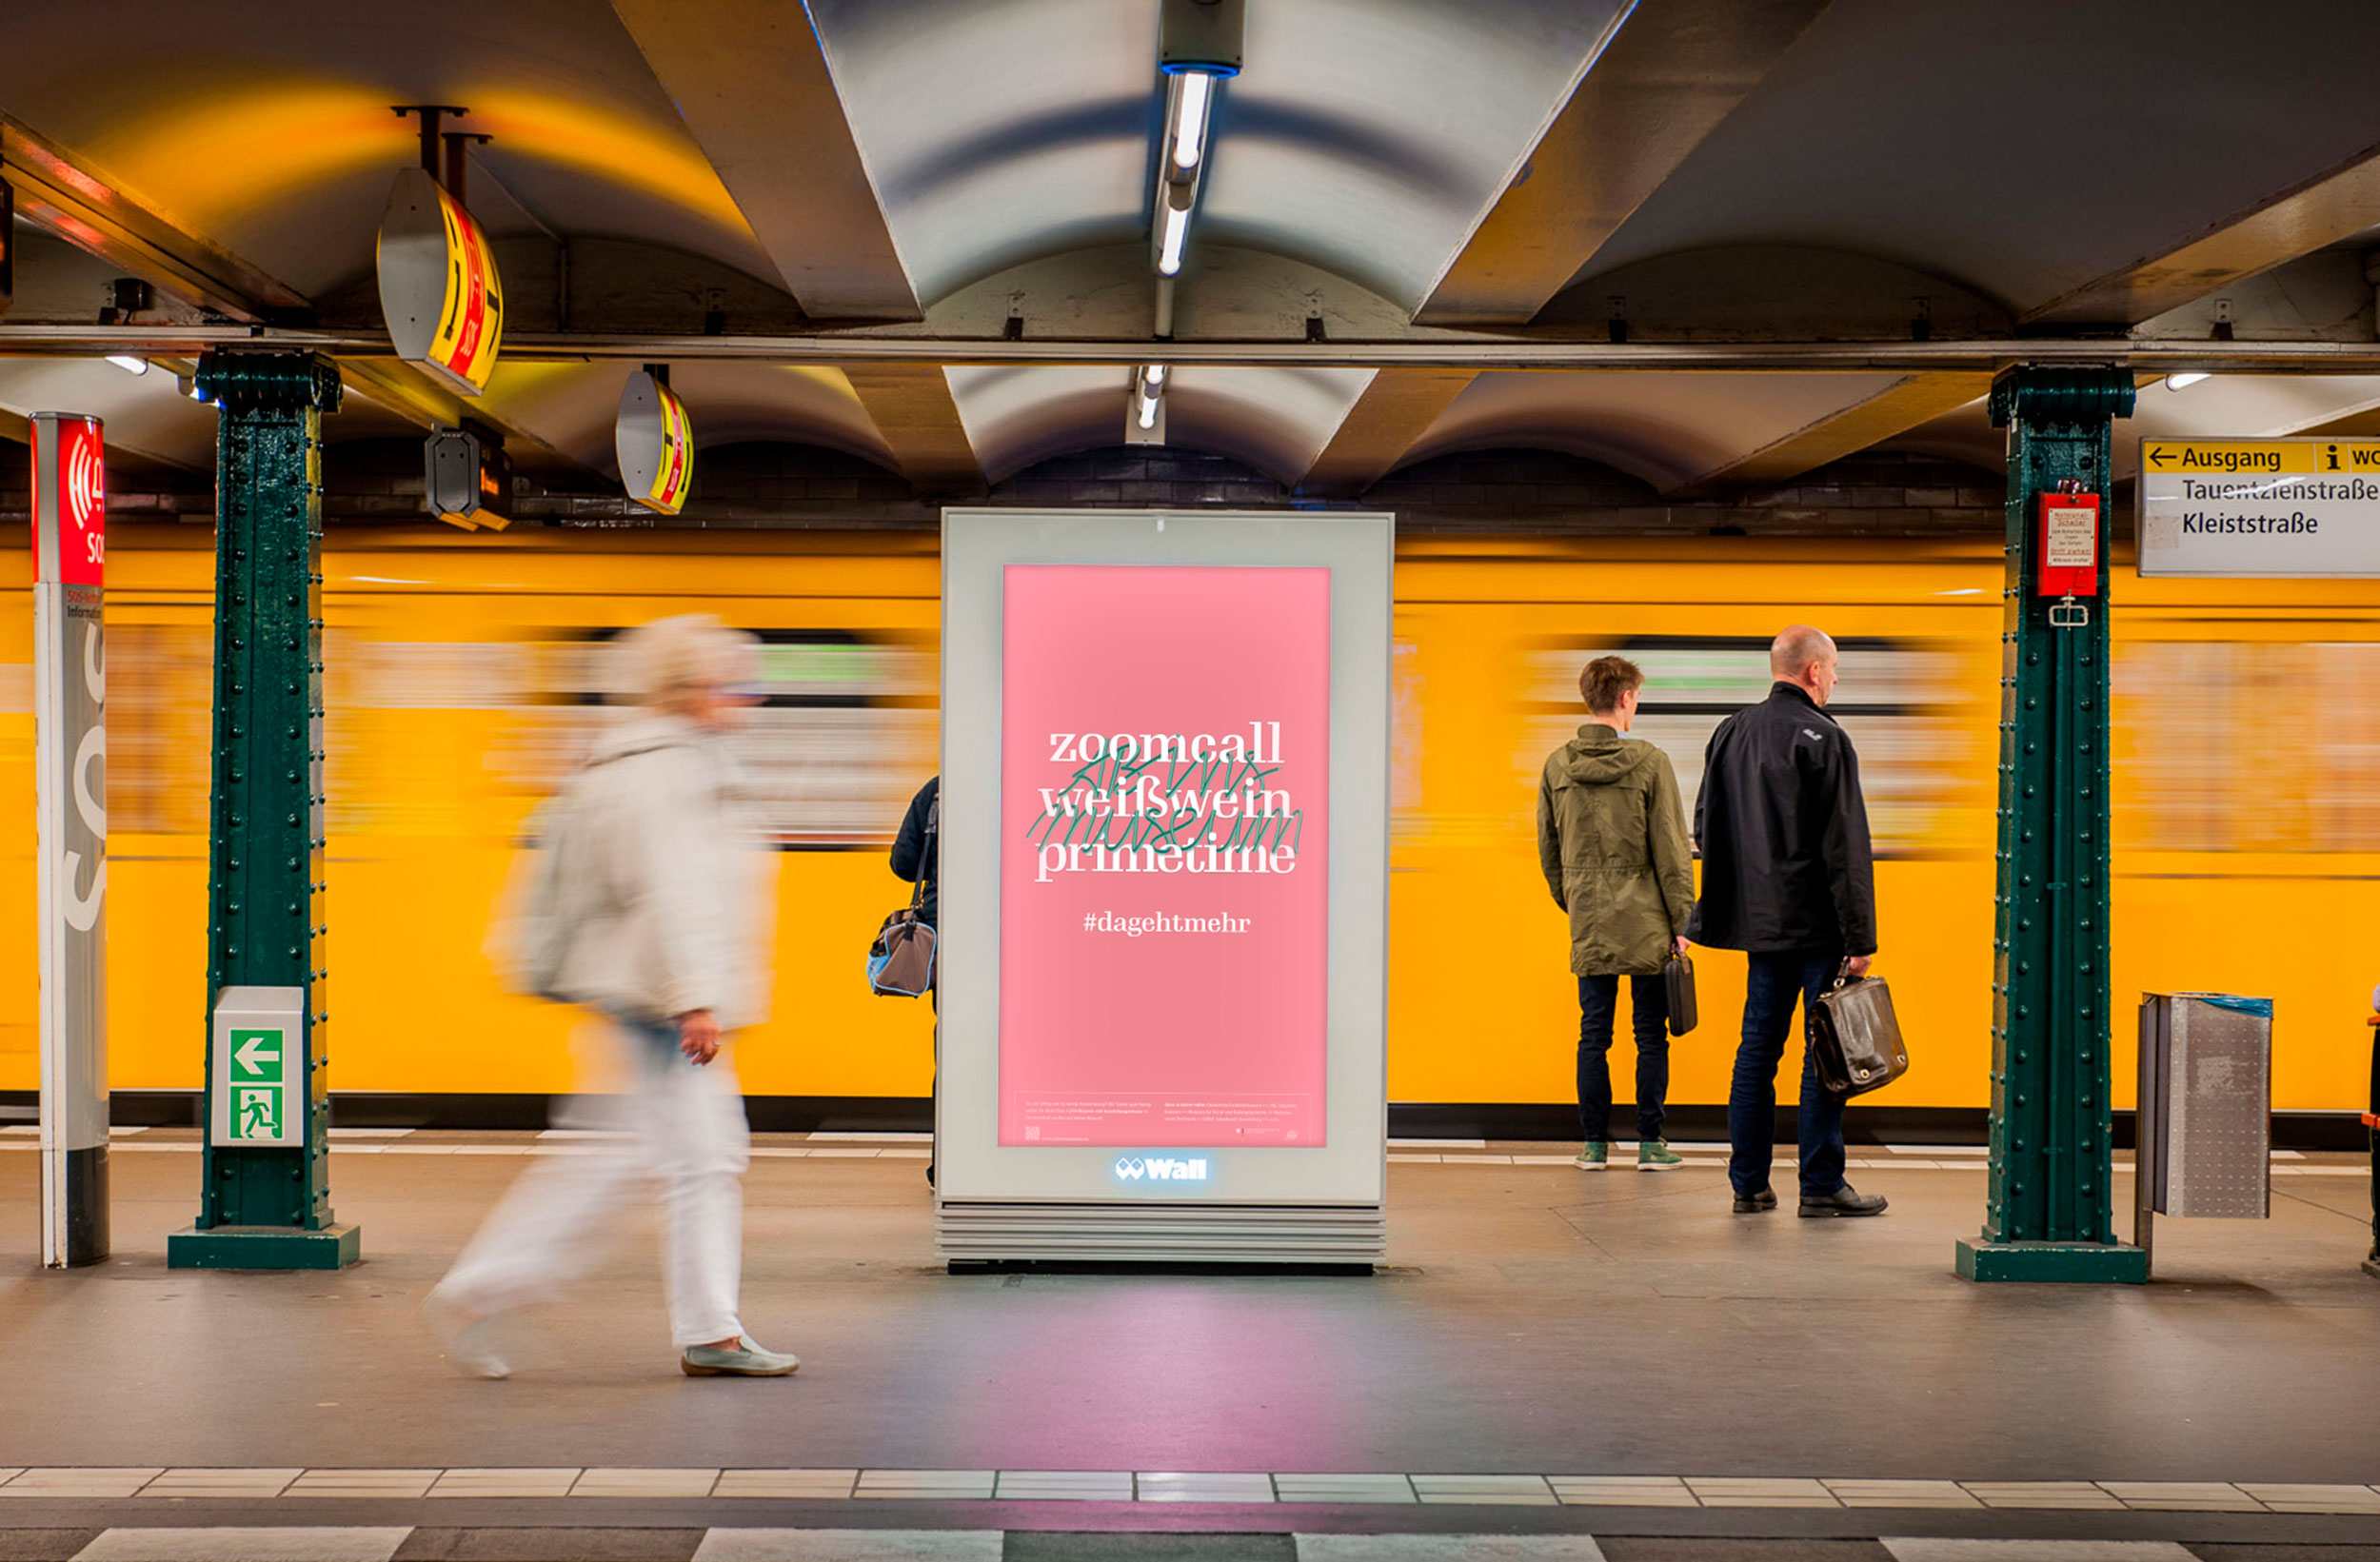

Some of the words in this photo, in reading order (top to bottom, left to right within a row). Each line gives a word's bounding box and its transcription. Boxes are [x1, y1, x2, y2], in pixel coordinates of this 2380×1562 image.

[2182, 448, 2281, 472] Ausgang
[2182, 511, 2319, 534] Kleiststraße
[1049, 722, 1285, 763] zoomcall
[1038, 775, 1295, 819] weißwein
[1034, 831, 1297, 883] primetime
[1083, 911, 1251, 938] #dagehtmehr
[1145, 1158, 1207, 1180] Wall
